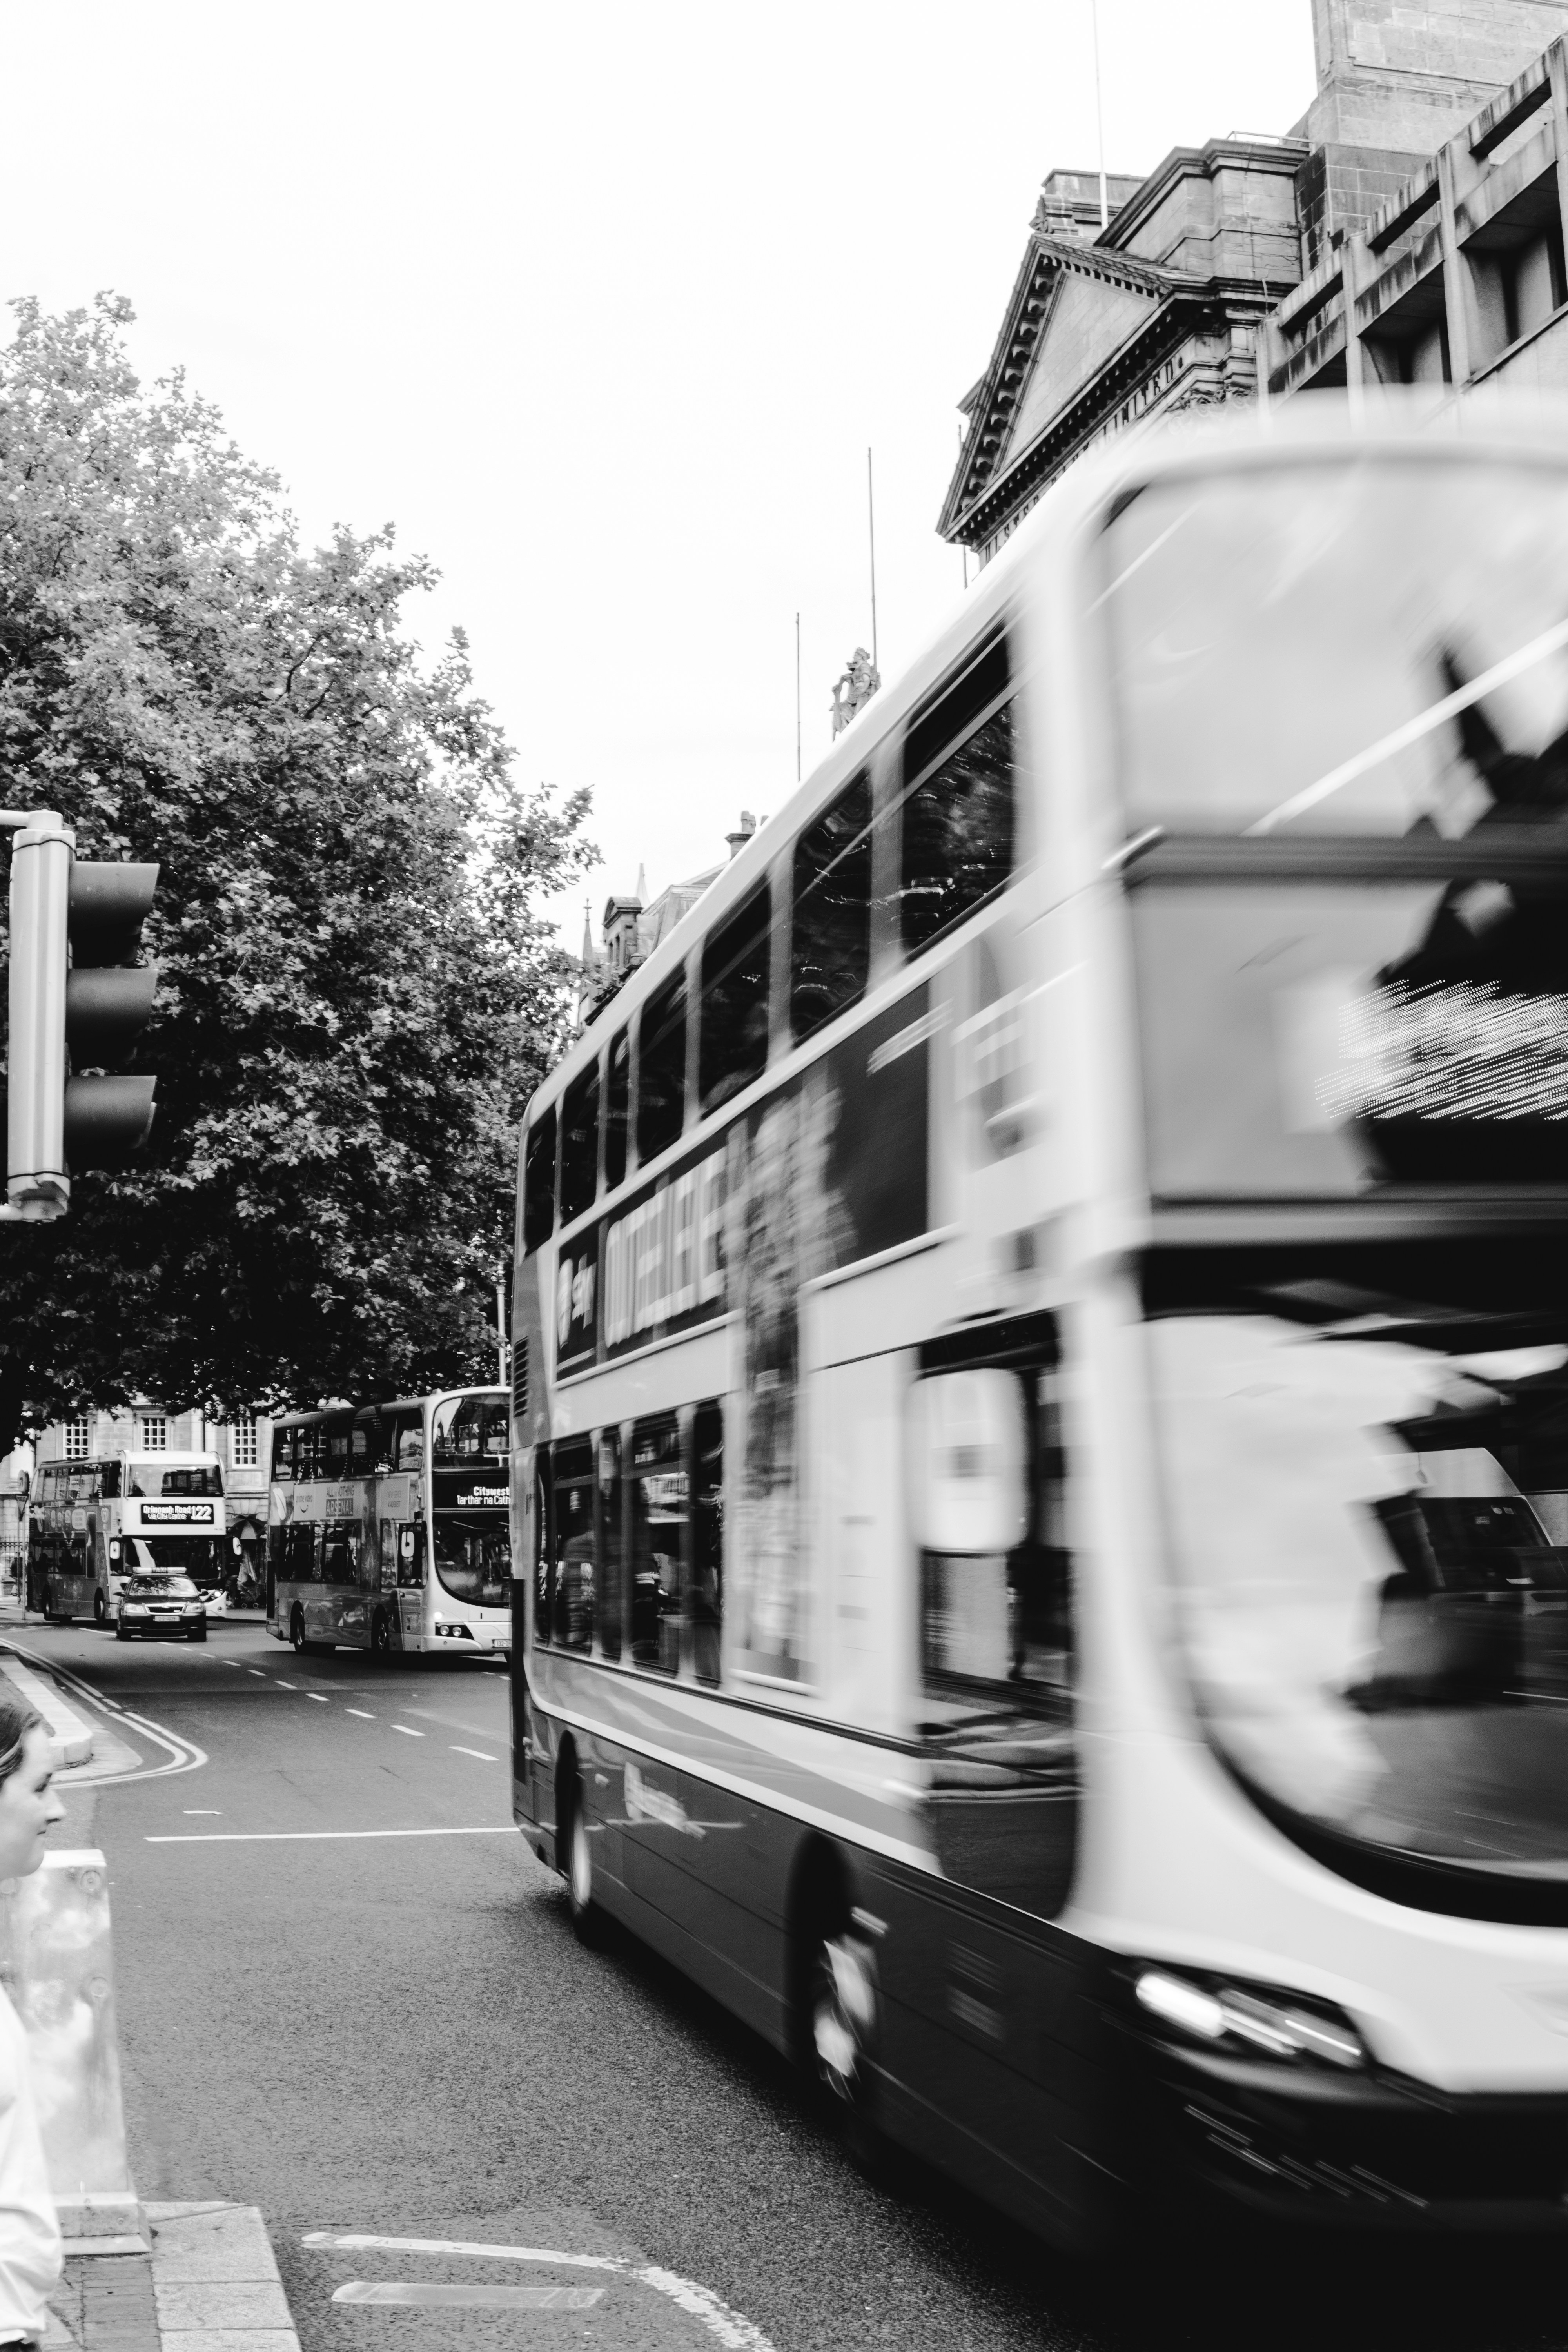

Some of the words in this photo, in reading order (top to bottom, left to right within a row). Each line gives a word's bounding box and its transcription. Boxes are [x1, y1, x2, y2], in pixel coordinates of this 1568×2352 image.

[473, 1486, 510, 1496] Citywest
[305, 1492, 313, 1502] video
[175, 1505, 192, 1514] Road
[191, 1505, 212, 1520] 122
[326, 1500, 353, 1515] ARSENAL
